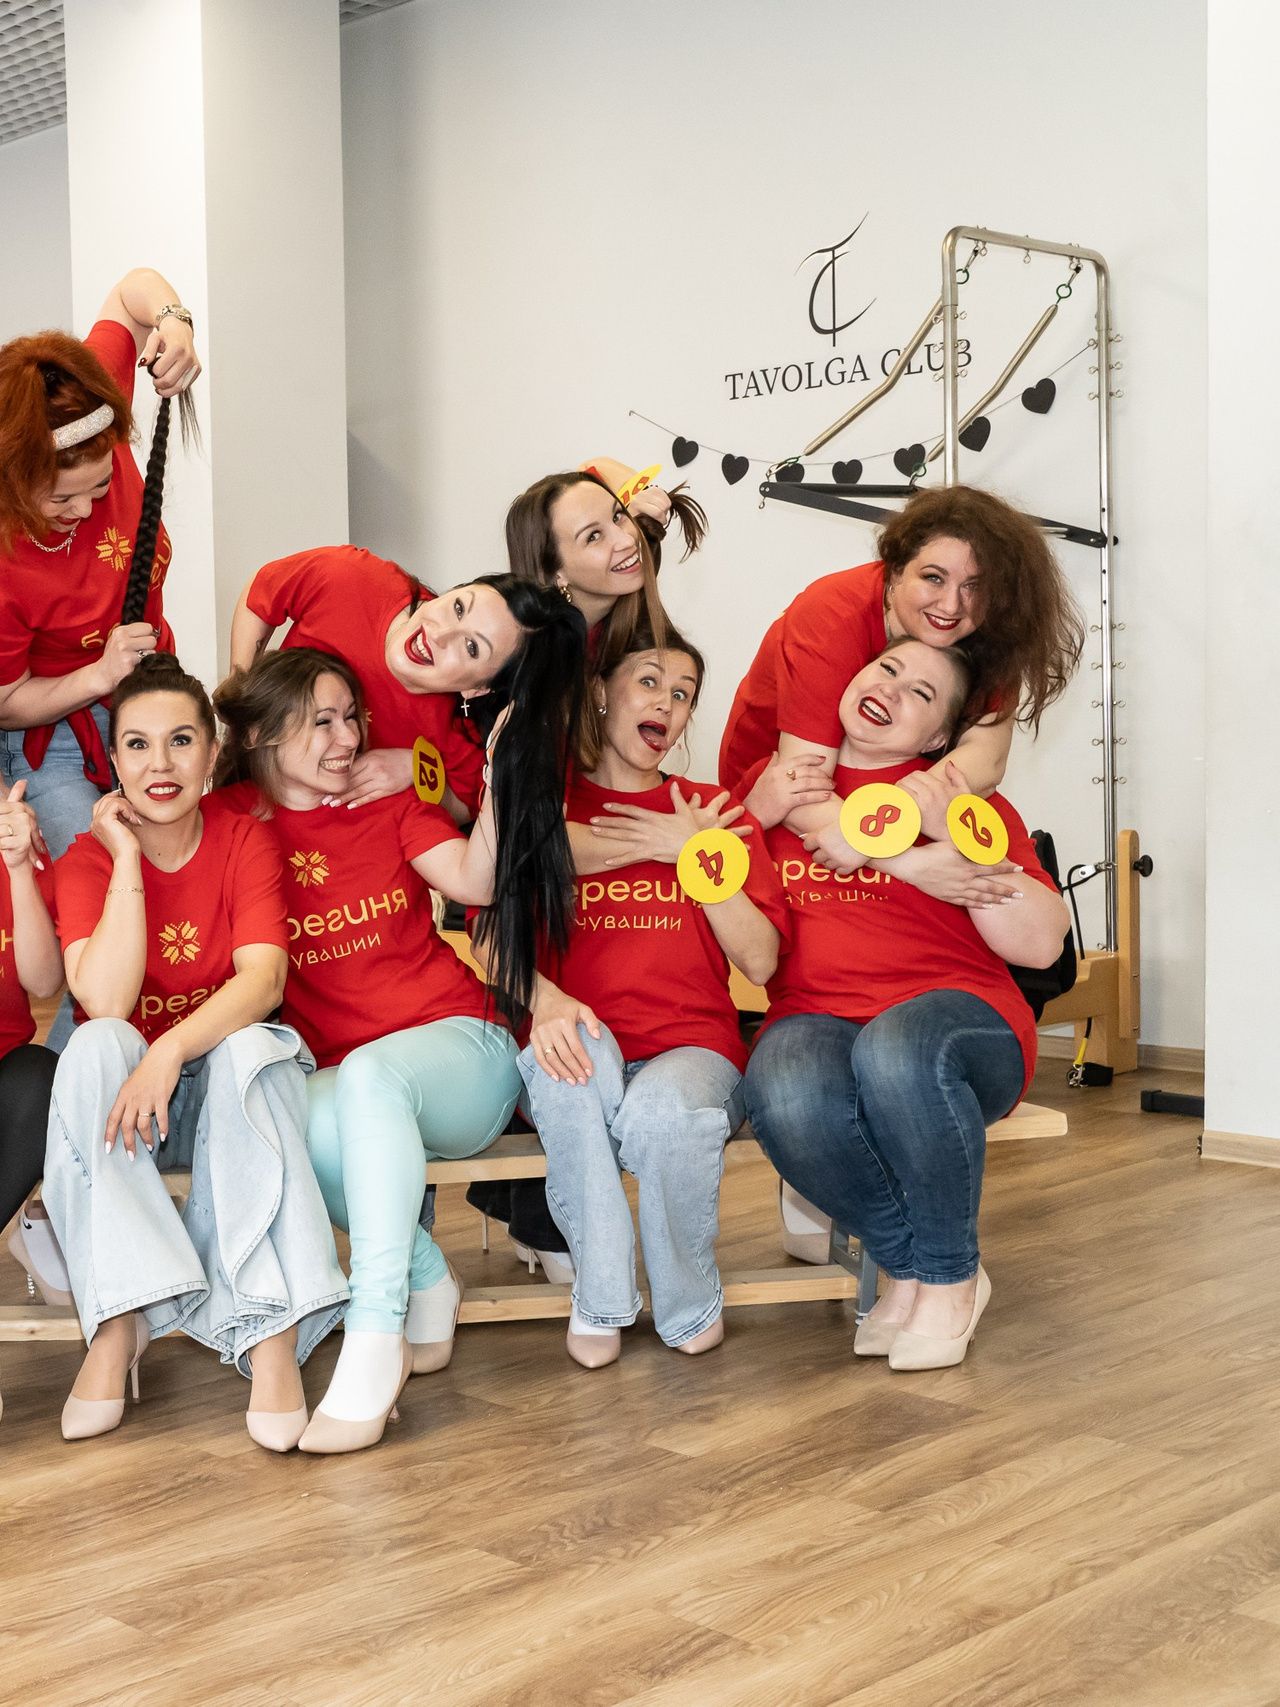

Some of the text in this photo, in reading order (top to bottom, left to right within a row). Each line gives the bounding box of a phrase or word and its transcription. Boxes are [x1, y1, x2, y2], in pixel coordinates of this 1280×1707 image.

[725, 354, 871, 400] TAVOLGA
[418, 751, 439, 792] 12
[860, 804, 901, 837] 8
[696, 849, 725, 887] 4
[289, 932, 381, 970] увашии
